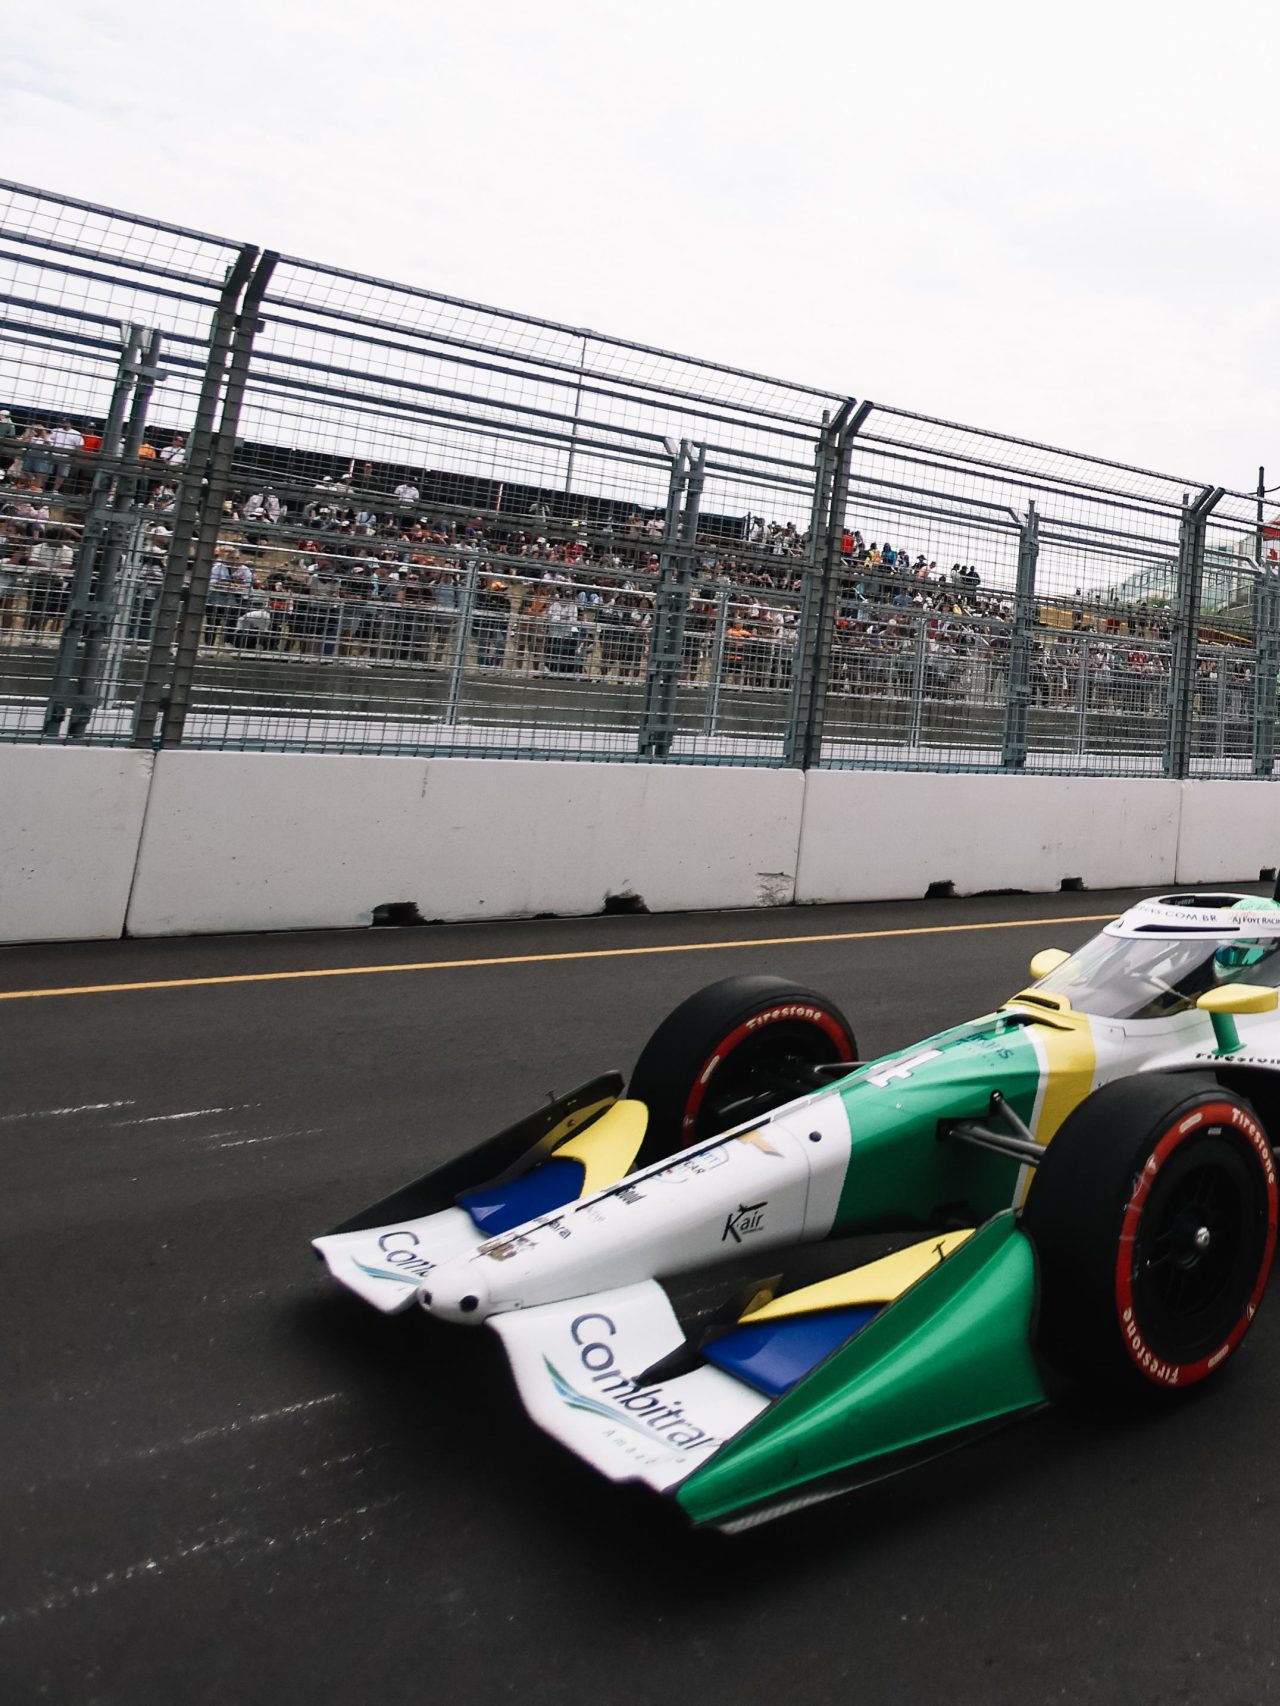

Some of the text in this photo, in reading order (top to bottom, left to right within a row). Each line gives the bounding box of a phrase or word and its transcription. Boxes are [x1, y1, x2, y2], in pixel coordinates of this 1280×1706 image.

[1242, 916, 1260, 925] FOYT
[745, 1006, 822, 1029] Firestone
[1232, 1107, 1275, 1184] Firestone
[1123, 1306, 1179, 1384] Firestone
